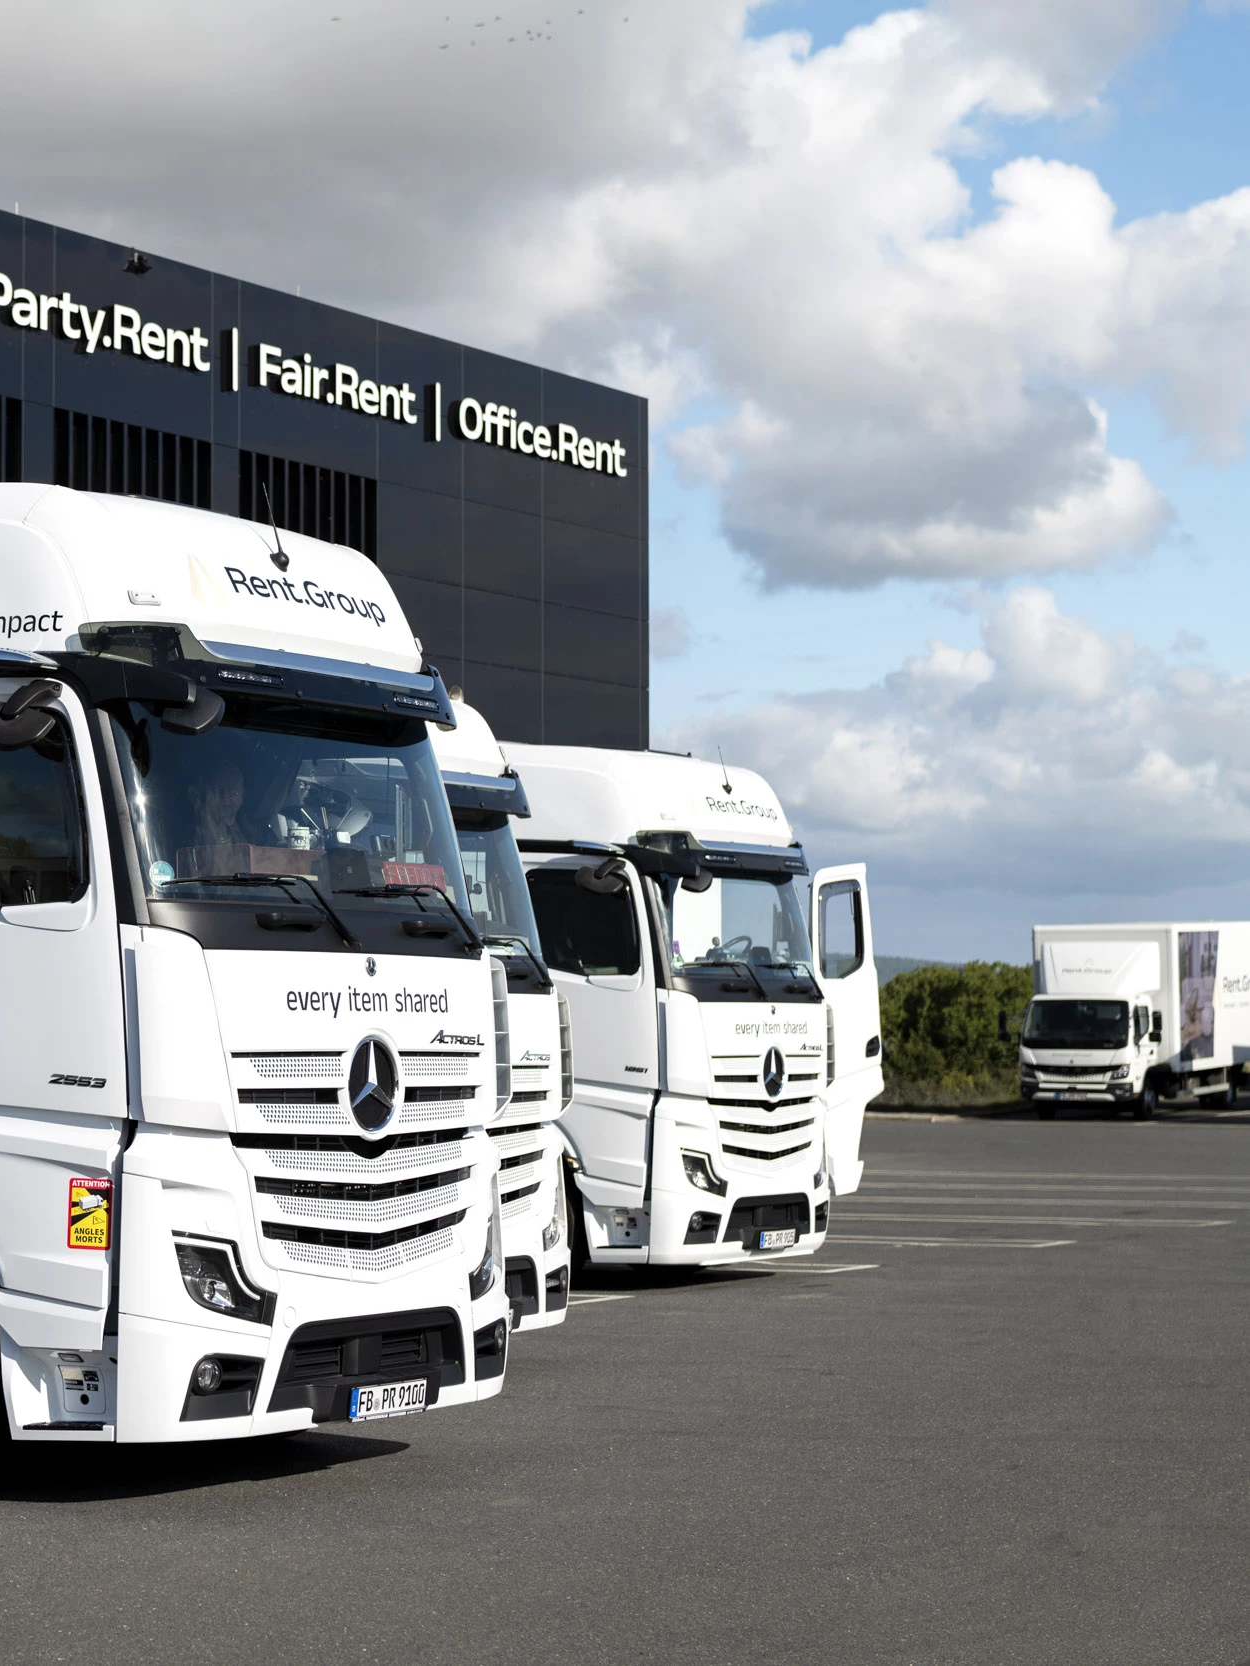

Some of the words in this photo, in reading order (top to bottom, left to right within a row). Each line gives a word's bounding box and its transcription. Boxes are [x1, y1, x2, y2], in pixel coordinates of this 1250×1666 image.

[259, 343, 418, 425] Fair.Rent
[459, 397, 627, 478] Office.Rent
[224, 566, 387, 627] Rent.Group
[705, 796, 778, 823] Rent.Group
[286, 988, 342, 1019] every
[348, 985, 388, 1012] item
[395, 986, 449, 1014] shared
[735, 1023, 761, 1038] every
[762, 1020, 781, 1035] item
[783, 1020, 808, 1035] shared
[48, 1073, 107, 1089] 2553
[72, 1180, 110, 1188] ATTENTION
[74, 1227, 104, 1236] ANGLES
[75, 1235, 103, 1243] MORTS
[359, 1391, 374, 1412] FB
[382, 1387, 396, 1409] PR
[399, 1384, 425, 1407] 9100
